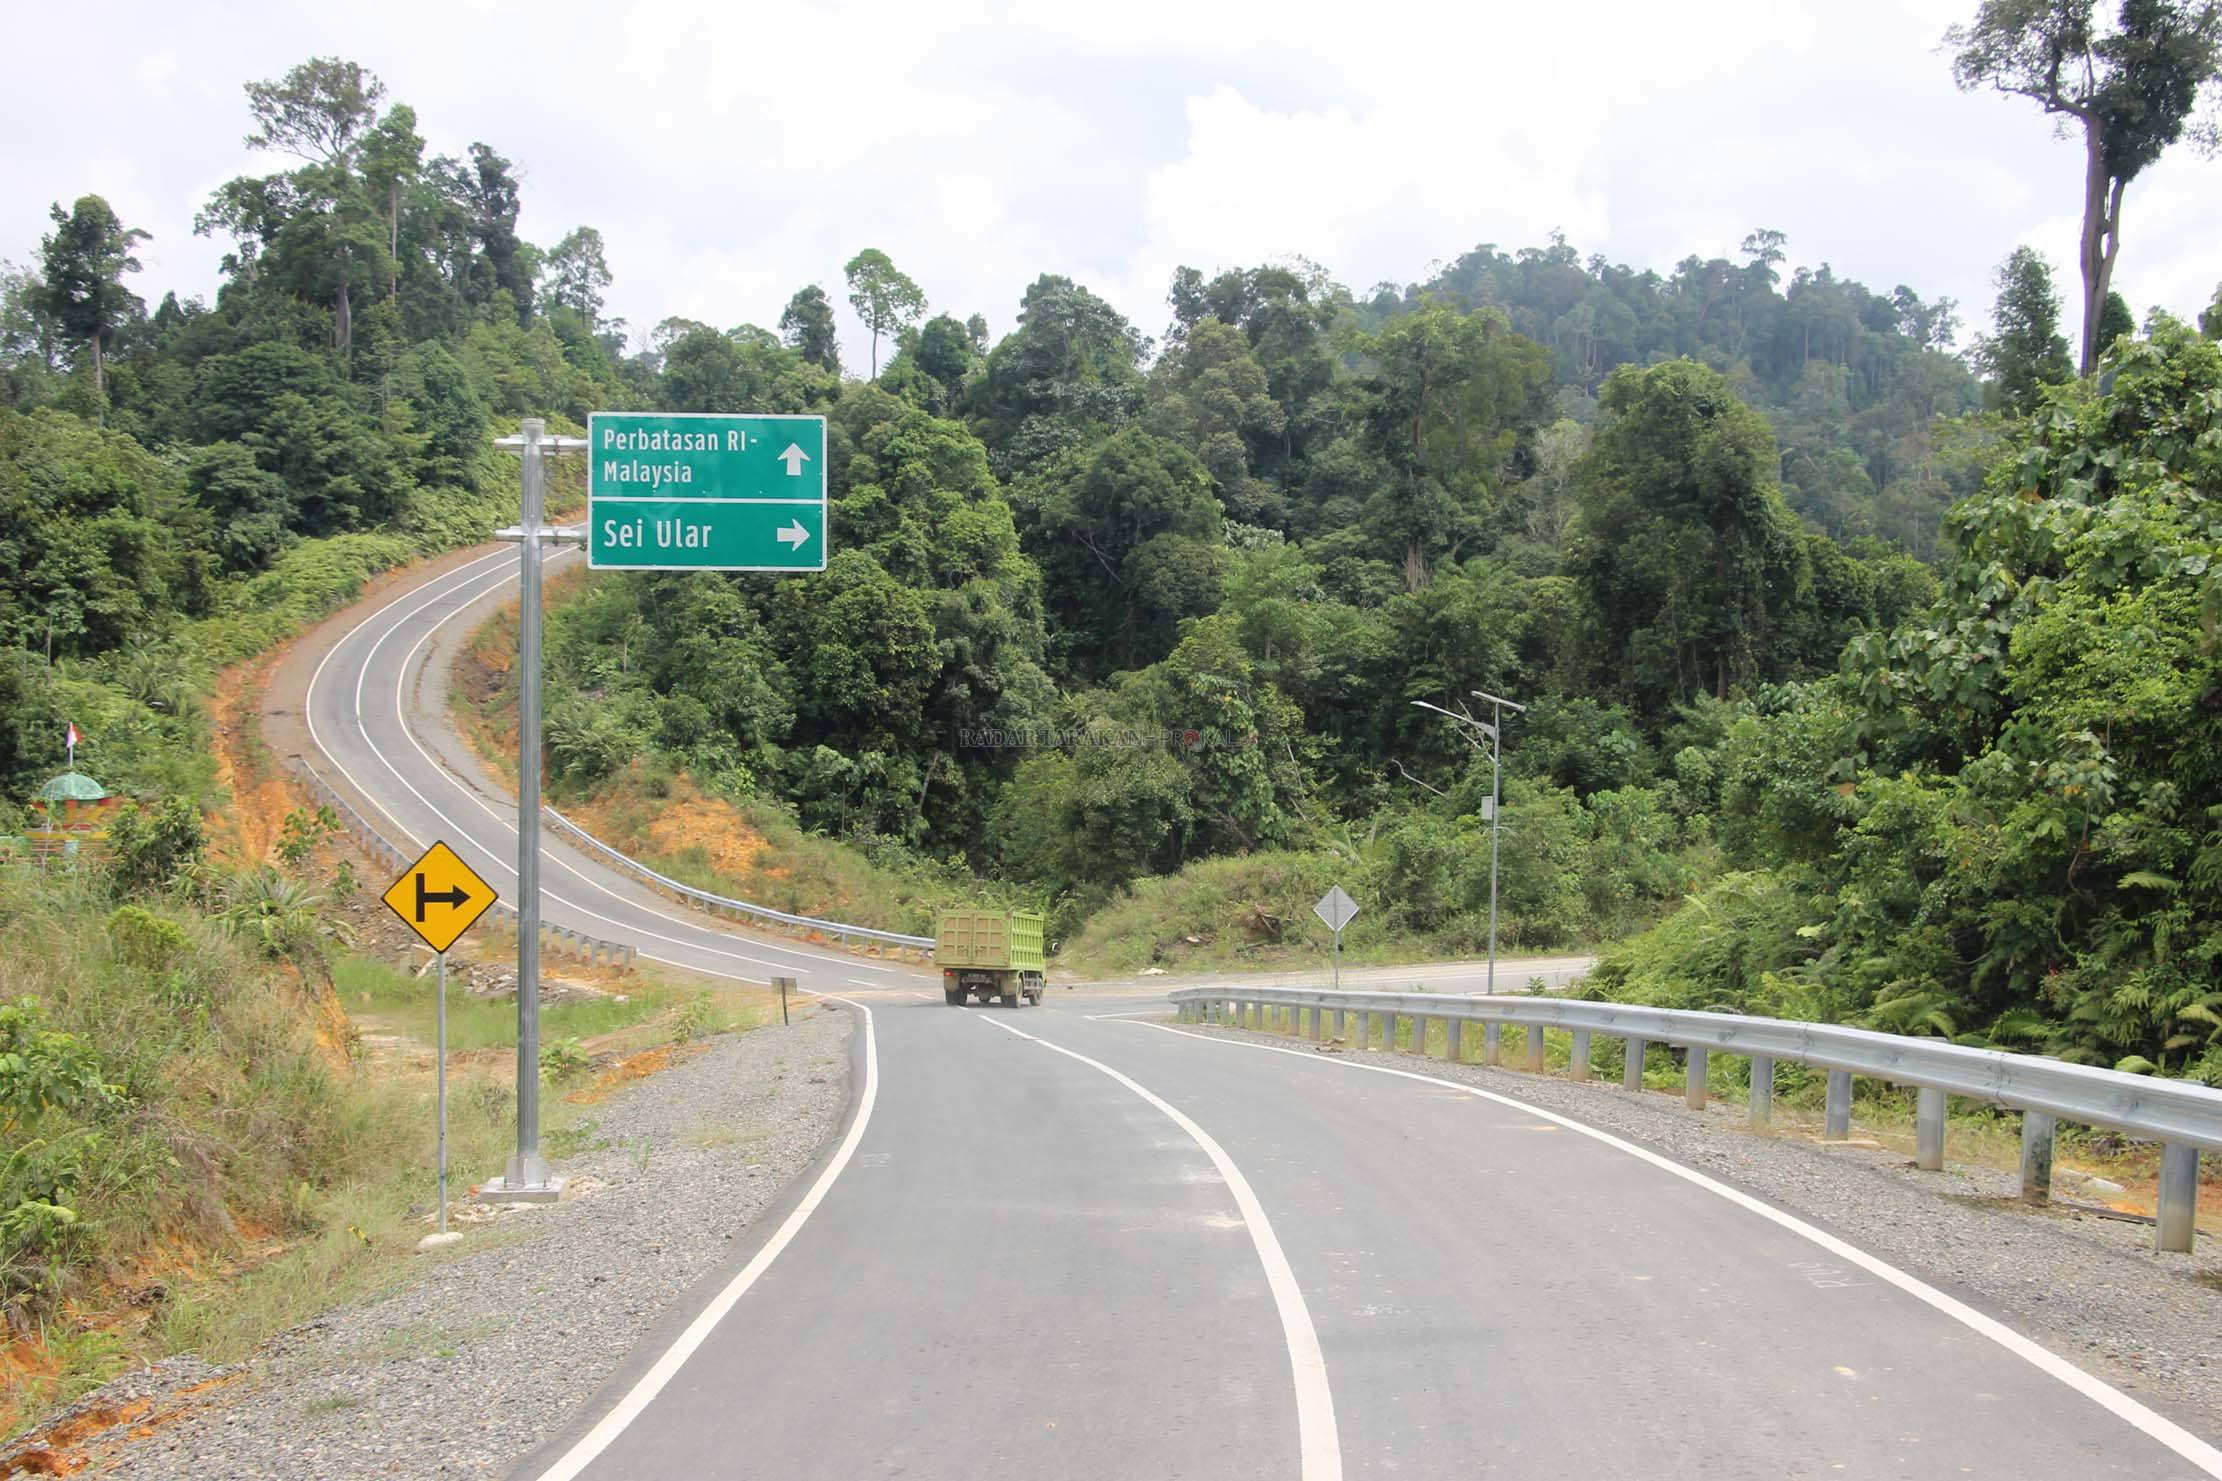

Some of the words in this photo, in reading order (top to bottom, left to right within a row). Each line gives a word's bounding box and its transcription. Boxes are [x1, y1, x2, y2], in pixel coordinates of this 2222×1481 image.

[603, 428, 719, 451] Perbatasan
[603, 459, 692, 489] Malaysia
[603, 518, 643, 547] Sei
[656, 518, 713, 548] Ular
